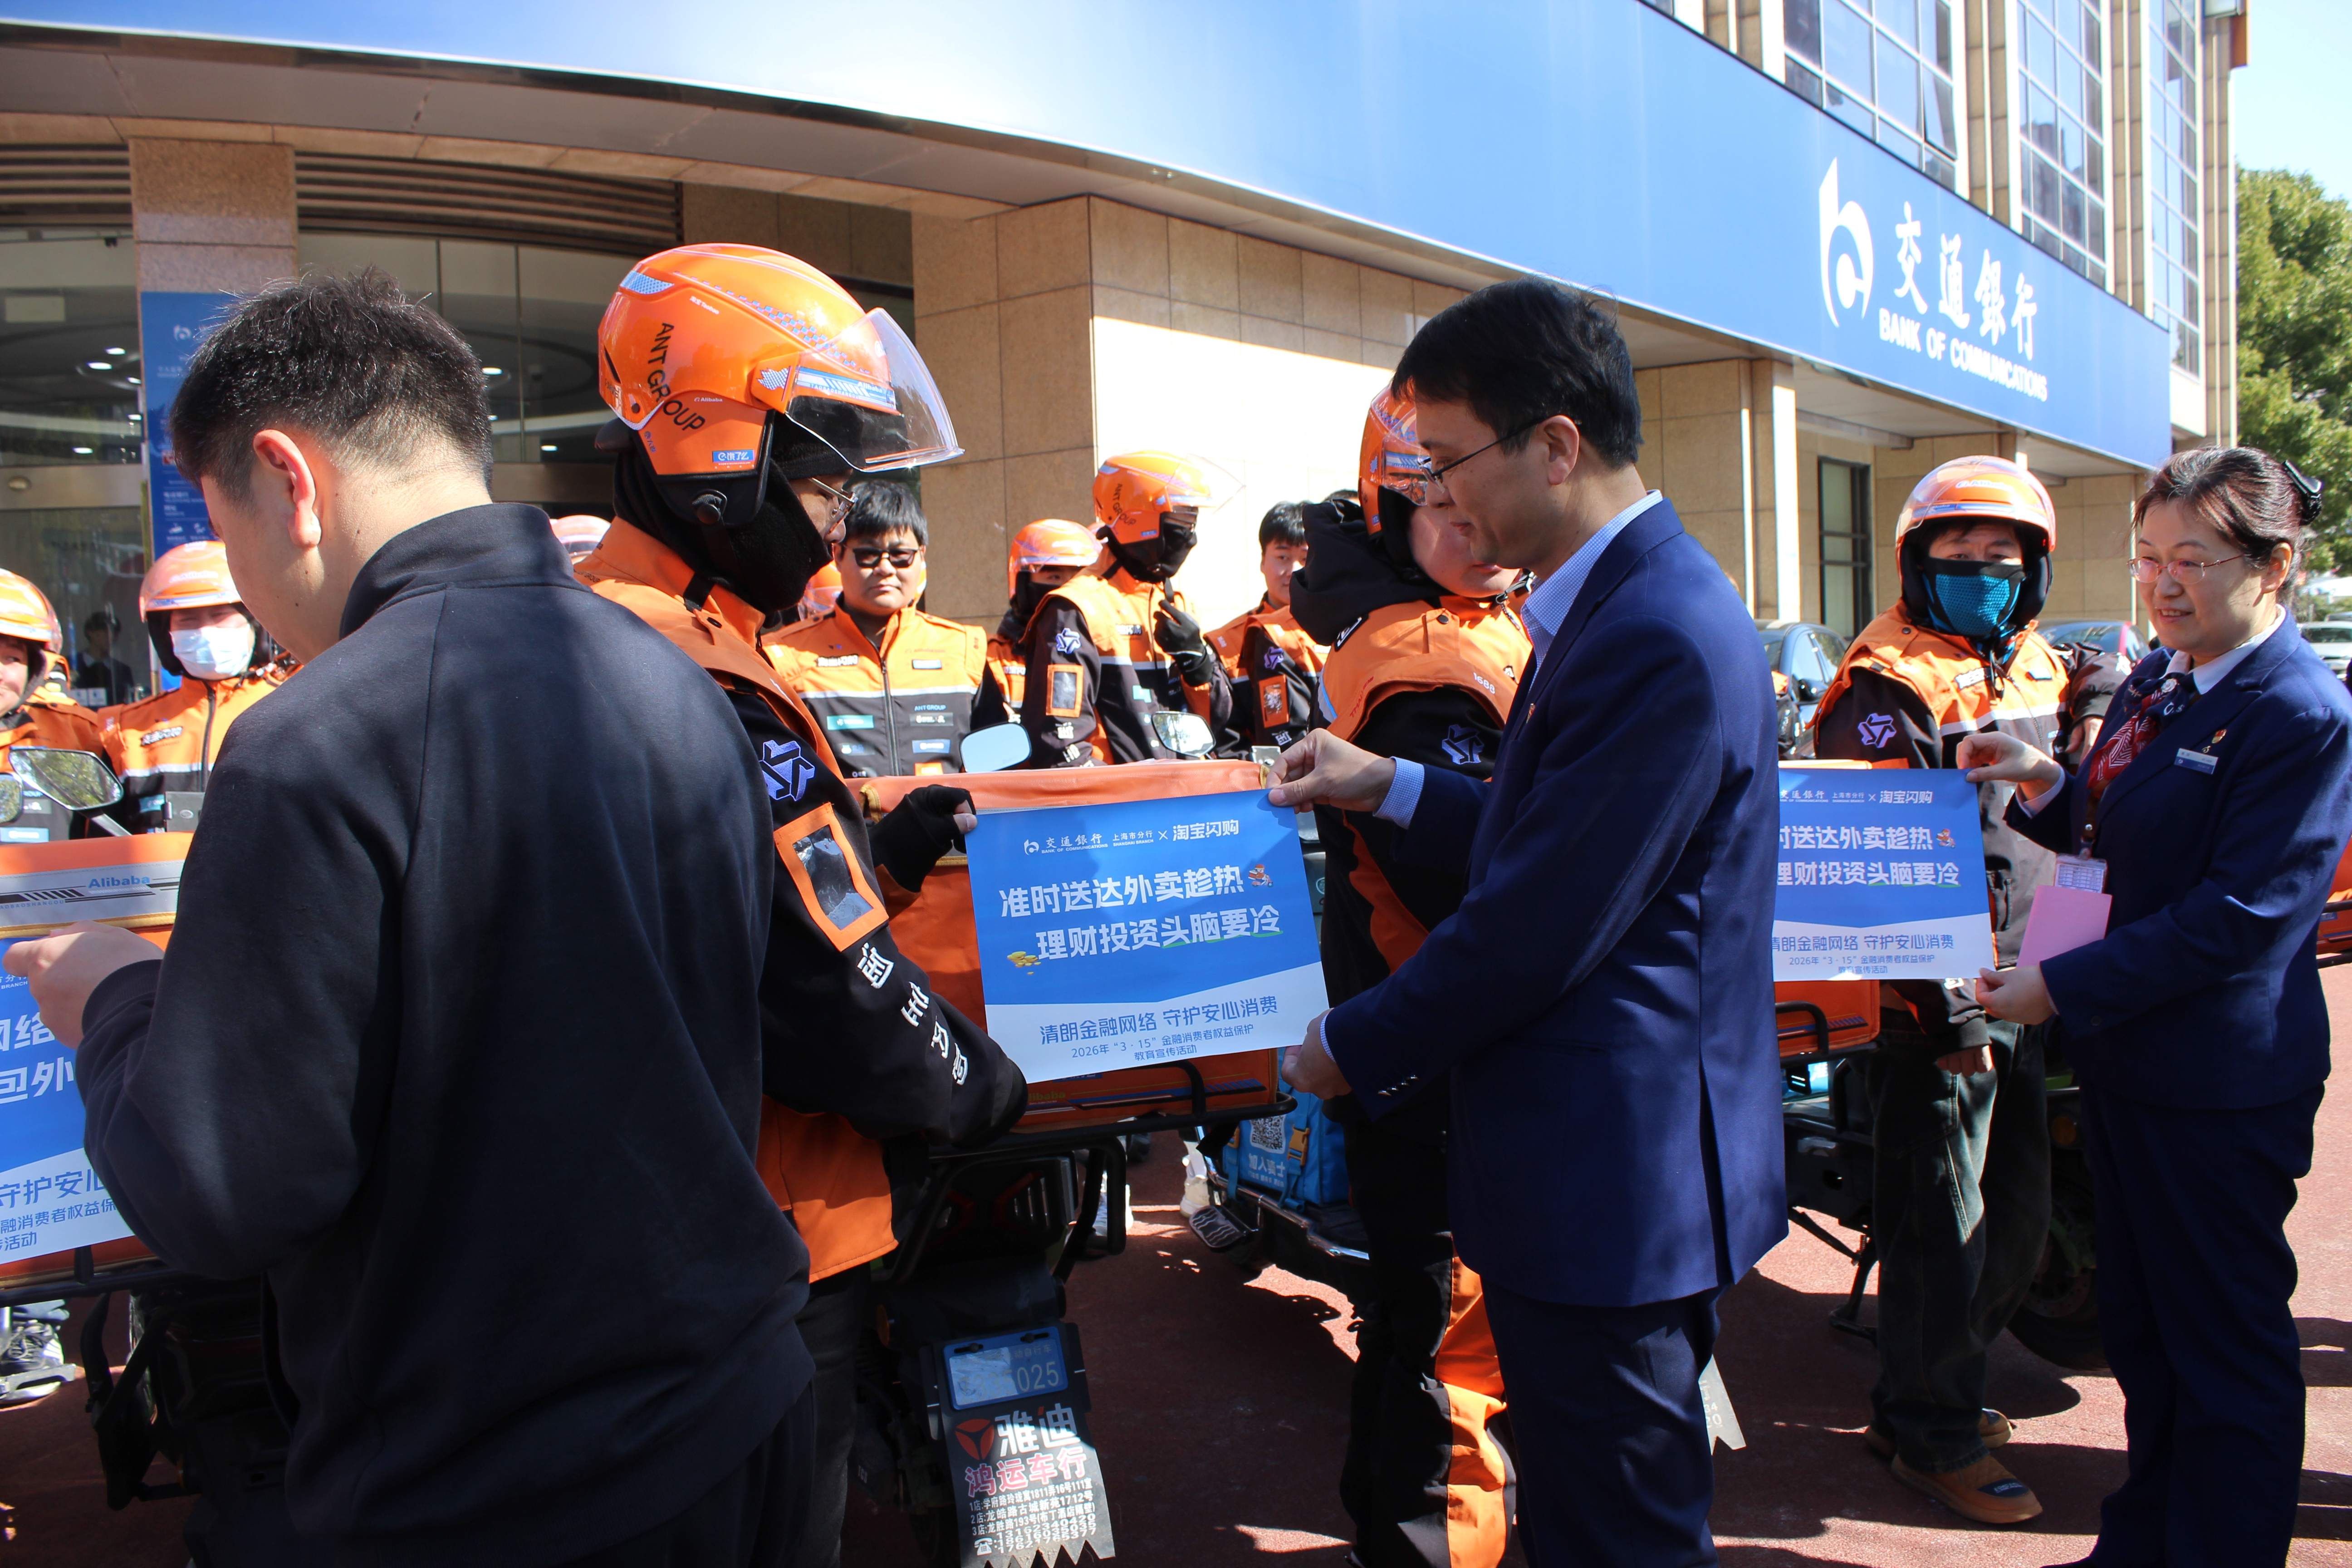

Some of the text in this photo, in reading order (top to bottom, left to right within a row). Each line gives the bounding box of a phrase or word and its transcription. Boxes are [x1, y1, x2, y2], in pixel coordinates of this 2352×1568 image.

[1893, 201, 2038, 361] 交通銀行
[701, 301, 720, 315] Taobao
[1879, 308, 2048, 402] BANK OF COMMUNICATIONS
[647, 323, 706, 431] ANT GROUP
[857, 381, 882, 393] Alibaba
[810, 383, 859, 399] TAOBAOSHANGOU
[1112, 484, 1136, 525] ANT GROUP
[1473, 672, 1496, 694] 1688
[1879, 790, 1933, 804] 淘宝闪购
[1045, 833, 1103, 848] 交通銀行
[1112, 830, 1153, 842] 上海市分行
[1172, 819, 1239, 842] 淘宝闪购
[1066, 843, 1108, 852] COMMUNICATIONS
[88, 876, 150, 888] Alibaba
[999, 864, 1245, 918] 准时送达外卖趁热
[1035, 904, 1280, 960] 理财投资头脑要冷
[1864, 934, 1955, 950] 守护安心消费
[1838, 965, 1888, 974] 教育宣传活动
[1, 981, 28, 990] BRANCH
[1039, 995, 1279, 1045] 清朗金融网络 守护安心消费
[0, 1012, 55, 1051] 络
[1134, 1044, 1197, 1061] 教育宣传活动
[1028, 1090, 1066, 1101] libaba
[1010, 1344, 1052, 1360] 动自行车
[995, 1402, 1081, 1458] 雅迪
[965, 1446, 1087, 1497] 鸿运车行
[996, 1513, 1096, 1539] 13162340420
